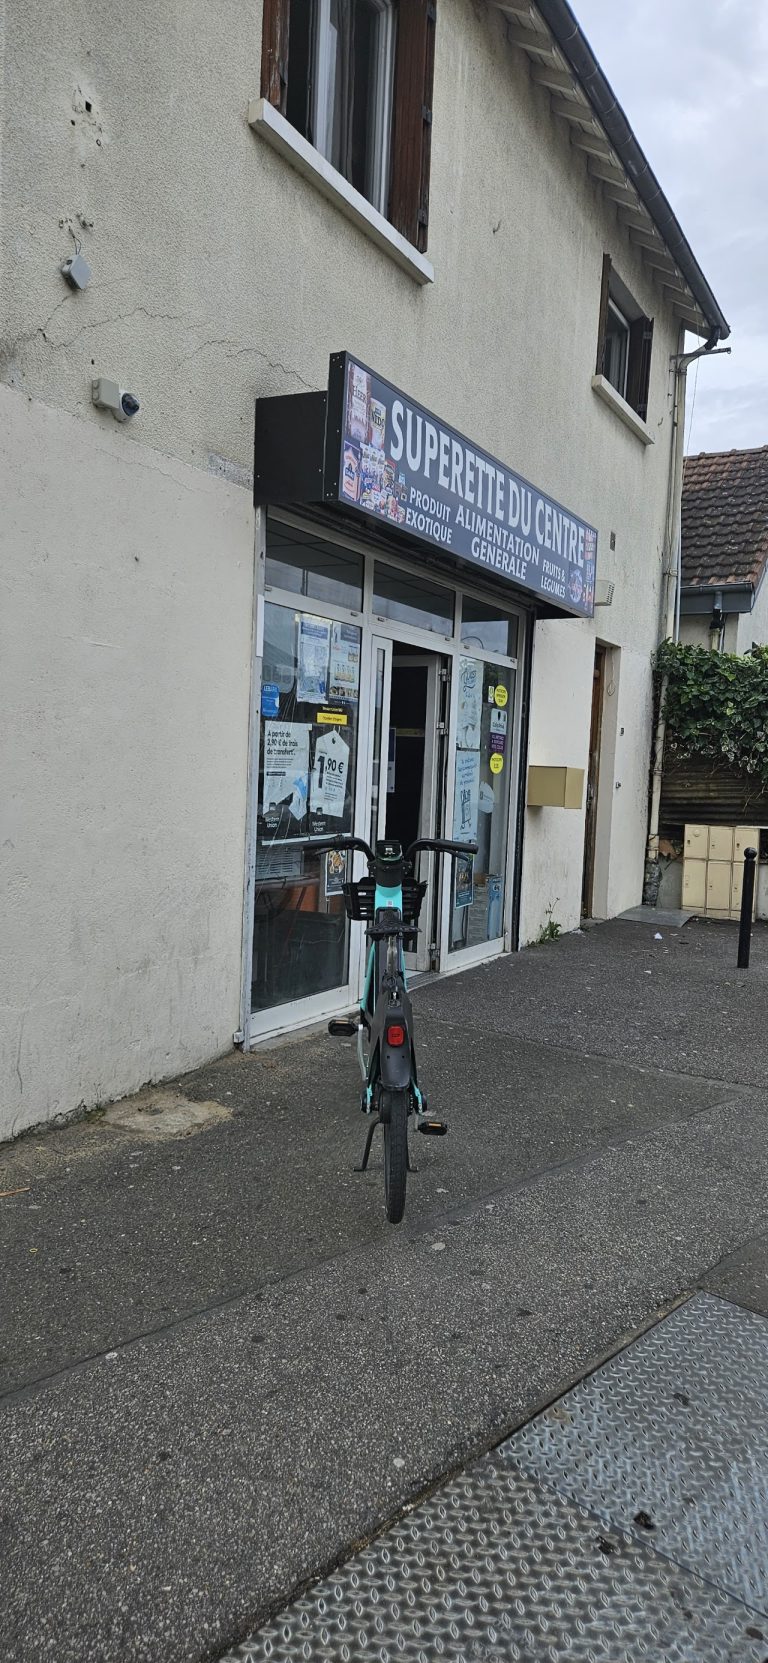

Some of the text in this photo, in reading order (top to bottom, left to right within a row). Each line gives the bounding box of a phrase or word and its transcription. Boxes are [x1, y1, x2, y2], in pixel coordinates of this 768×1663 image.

[390, 400, 505, 521] SUPERETTE
[509, 474, 532, 536] DU
[535, 499, 585, 568] CENTRE
[410, 487, 451, 523] PRODUIT
[405, 507, 452, 545] EXOTIQUE
[455, 505, 540, 566] ALIMENTATION
[471, 537, 527, 581] GENERALE
[542, 559, 566, 583] FRUITS &
[541, 575, 566, 599] LEGUMES
[282, 739, 288, 747] de
[285, 730, 291, 738] de
[266, 747, 273, 755] de
[338, 762, 344, 774] €
